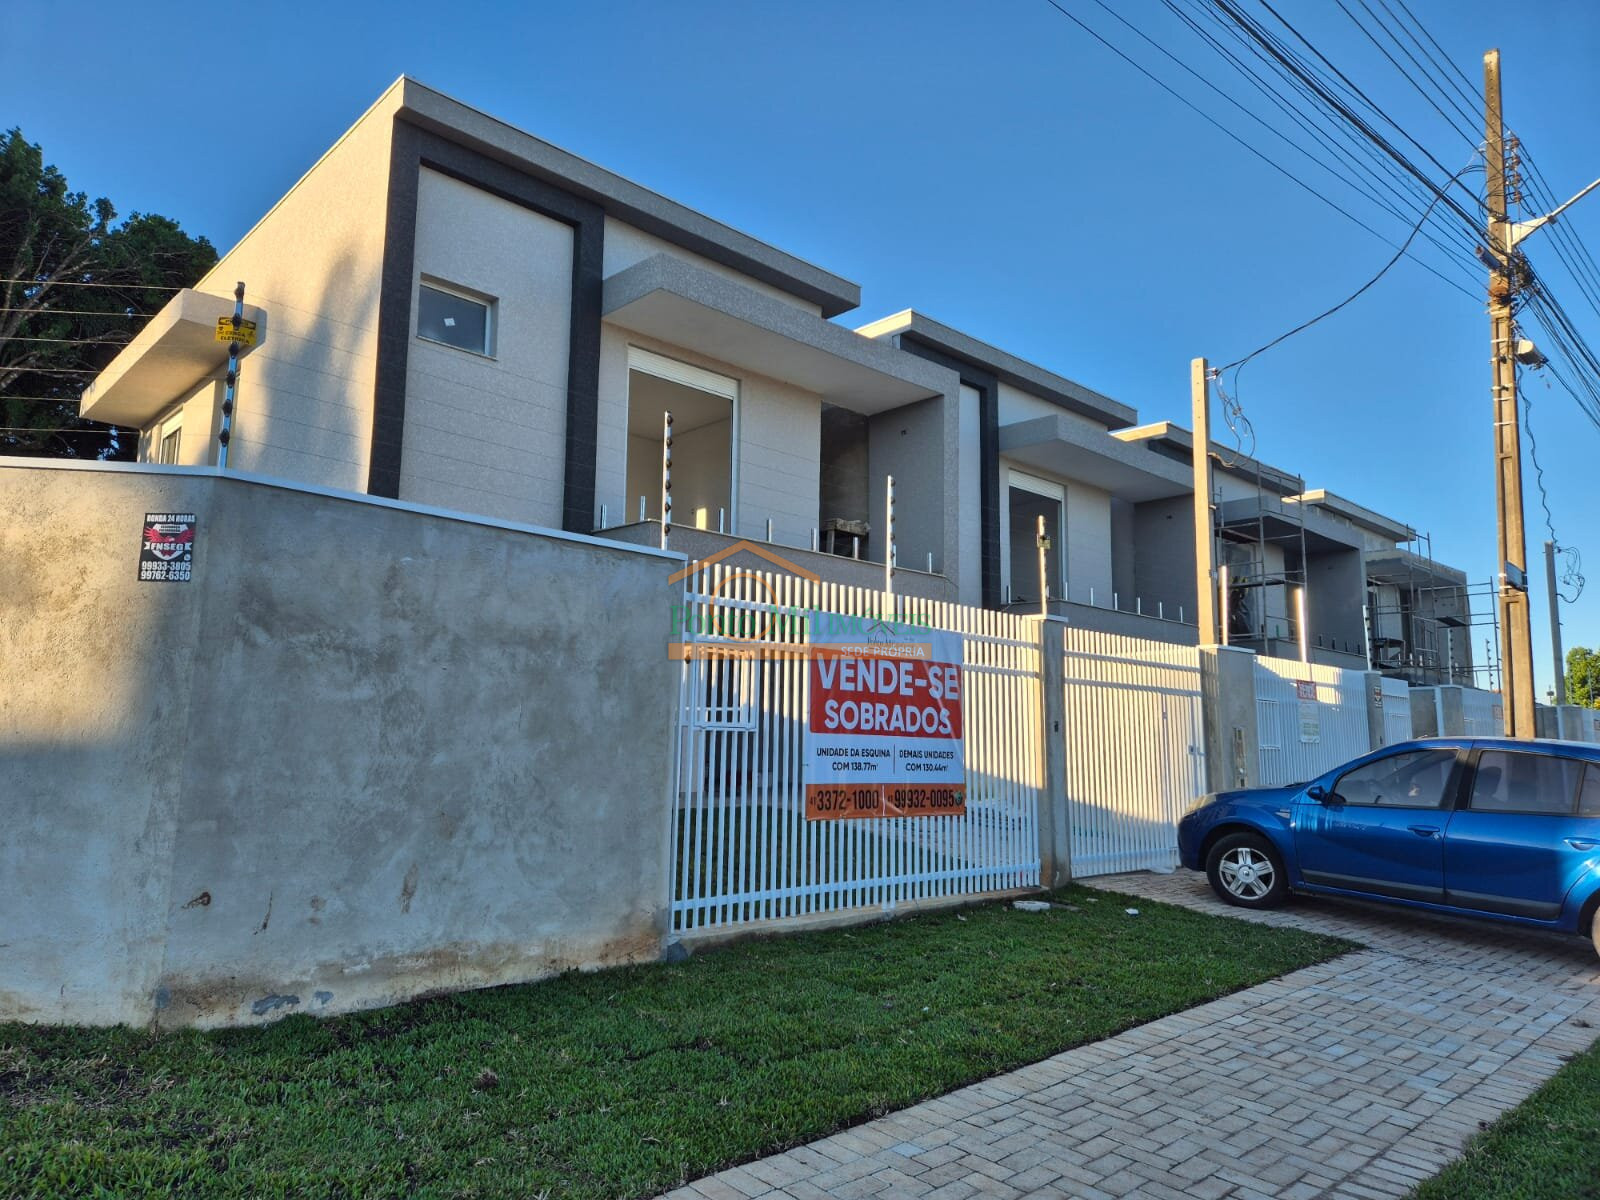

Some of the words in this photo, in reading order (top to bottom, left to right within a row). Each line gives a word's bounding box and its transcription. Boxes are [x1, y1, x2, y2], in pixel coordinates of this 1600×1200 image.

[146, 514, 167, 523] RONDA
[168, 514, 175, 523] 24
[176, 514, 196, 523] HORAS
[140, 570, 191, 581] 99762-6350
[816, 653, 959, 701] VENDE-SE
[824, 699, 952, 735] SOBRADOS
[816, 747, 849, 757] UNIDADE
[850, 748, 860, 757] DA
[861, 748, 891, 758] ESQUINA
[899, 749, 923, 759] DEMAIS
[923, 750, 954, 760] UNIDADES
[832, 761, 850, 771] COM
[905, 762, 922, 772] COM
[817, 790, 879, 811] 3372-1000
[895, 789, 955, 809] 99932-0095
